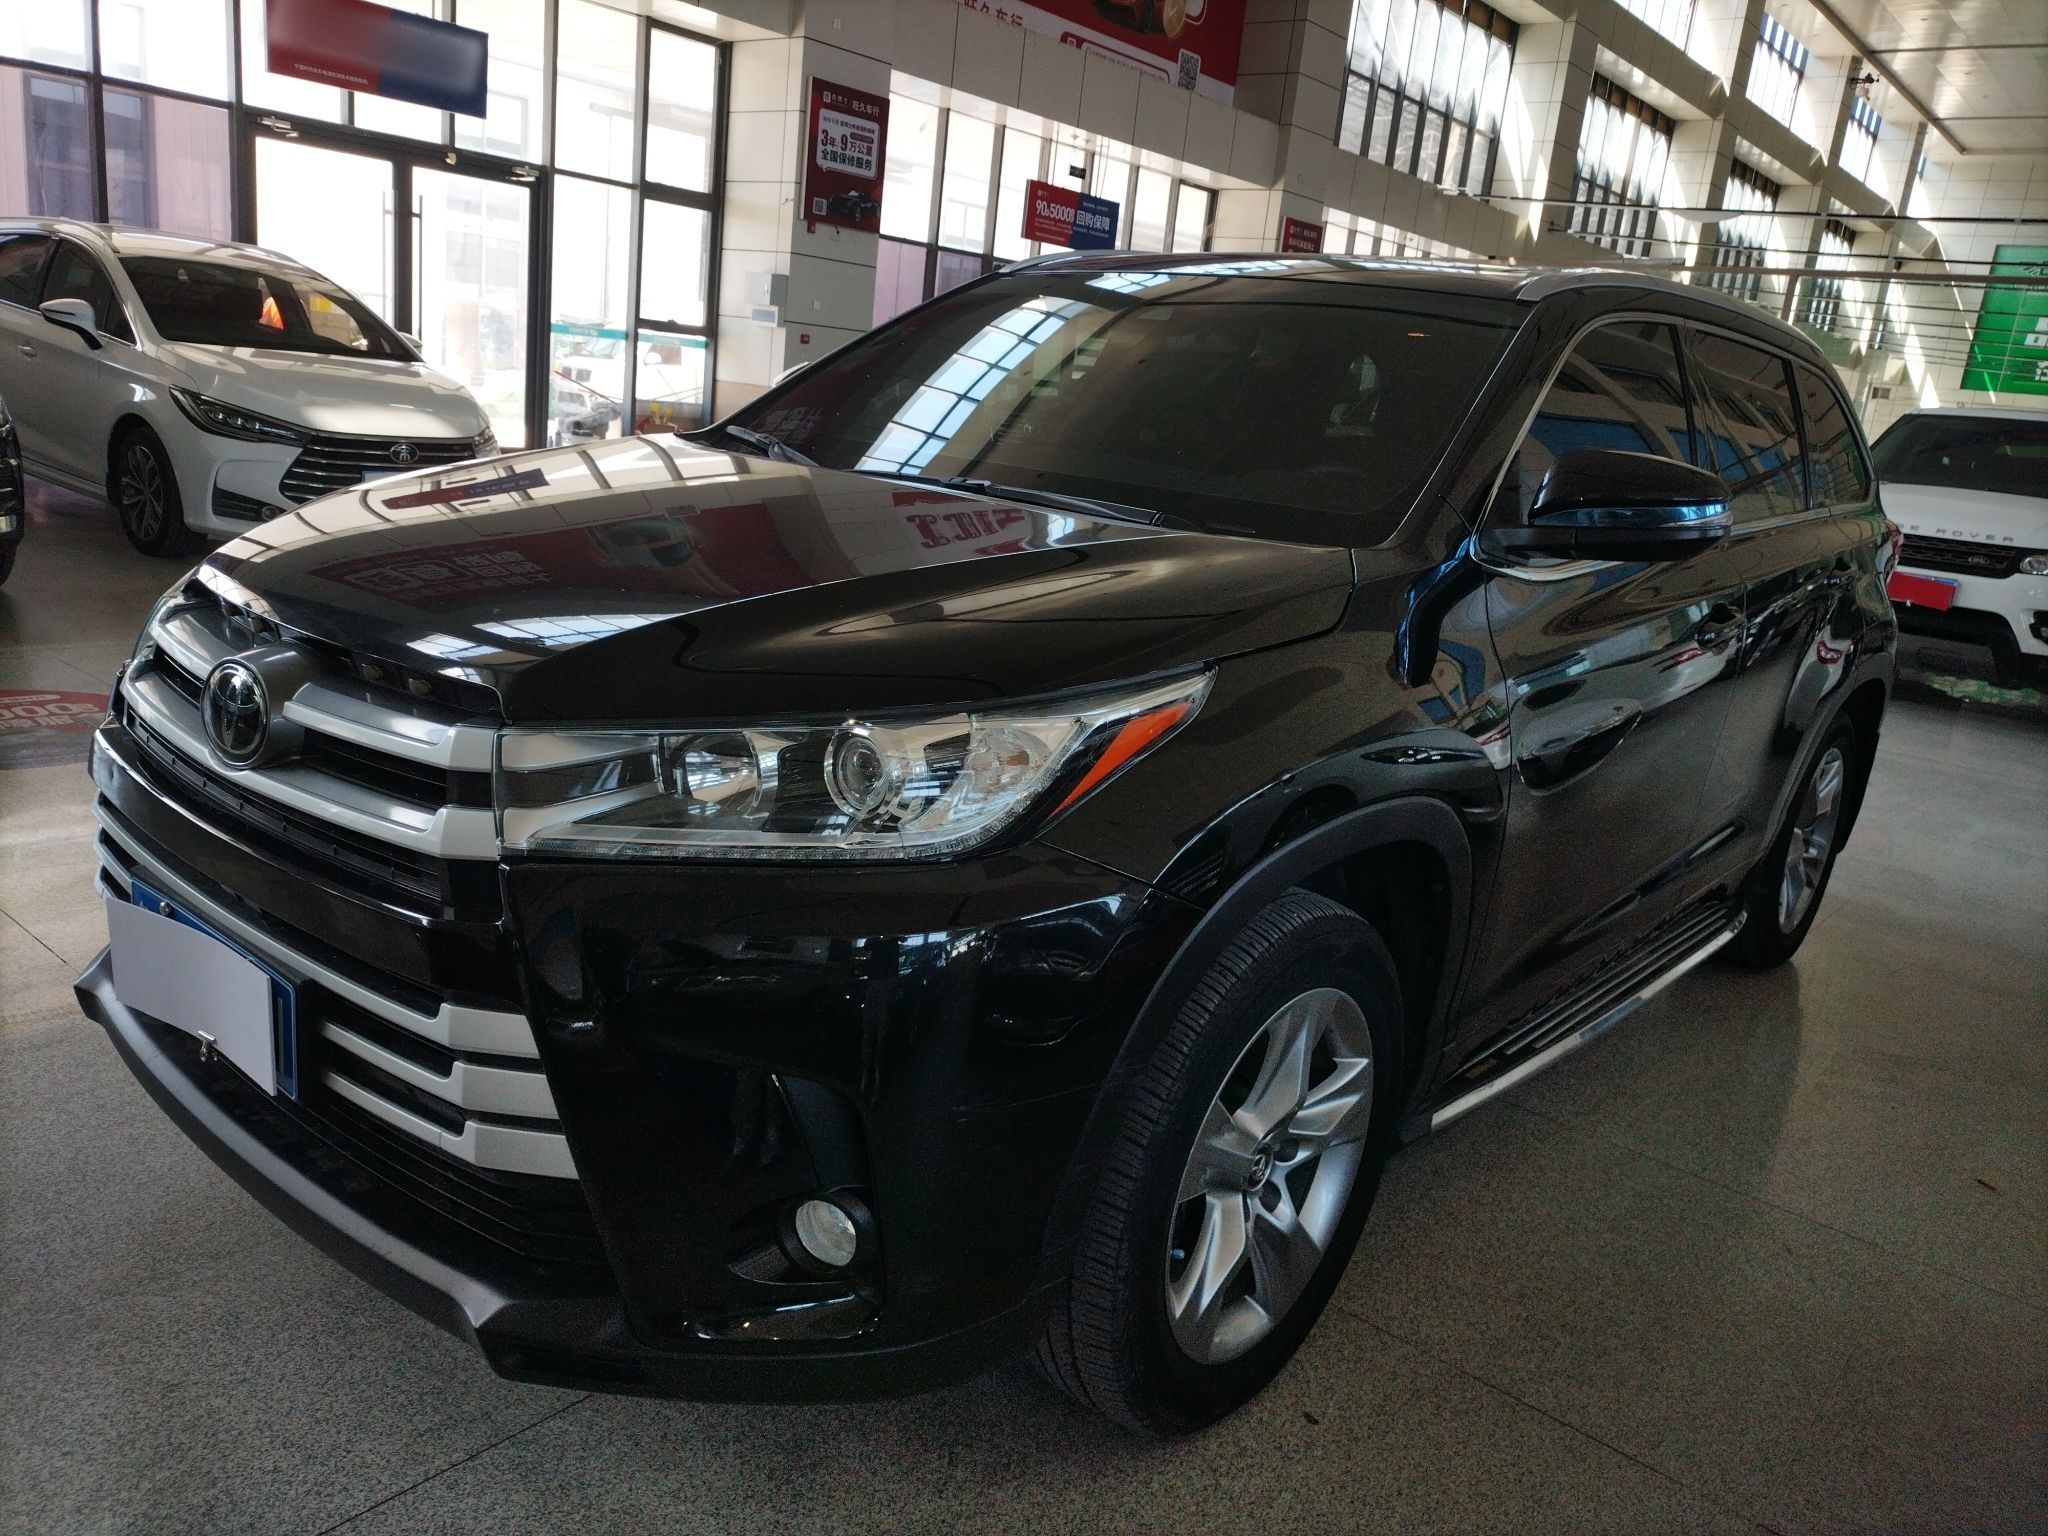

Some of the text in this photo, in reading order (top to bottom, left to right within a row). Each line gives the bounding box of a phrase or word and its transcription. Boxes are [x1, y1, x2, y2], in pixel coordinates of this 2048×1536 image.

[852, 100, 880, 117] 旺久车行
[821, 148, 873, 171] 全国保修服务
[1076, 210, 1110, 232] 回购保障
[1935, 528, 2015, 543] ROVER
